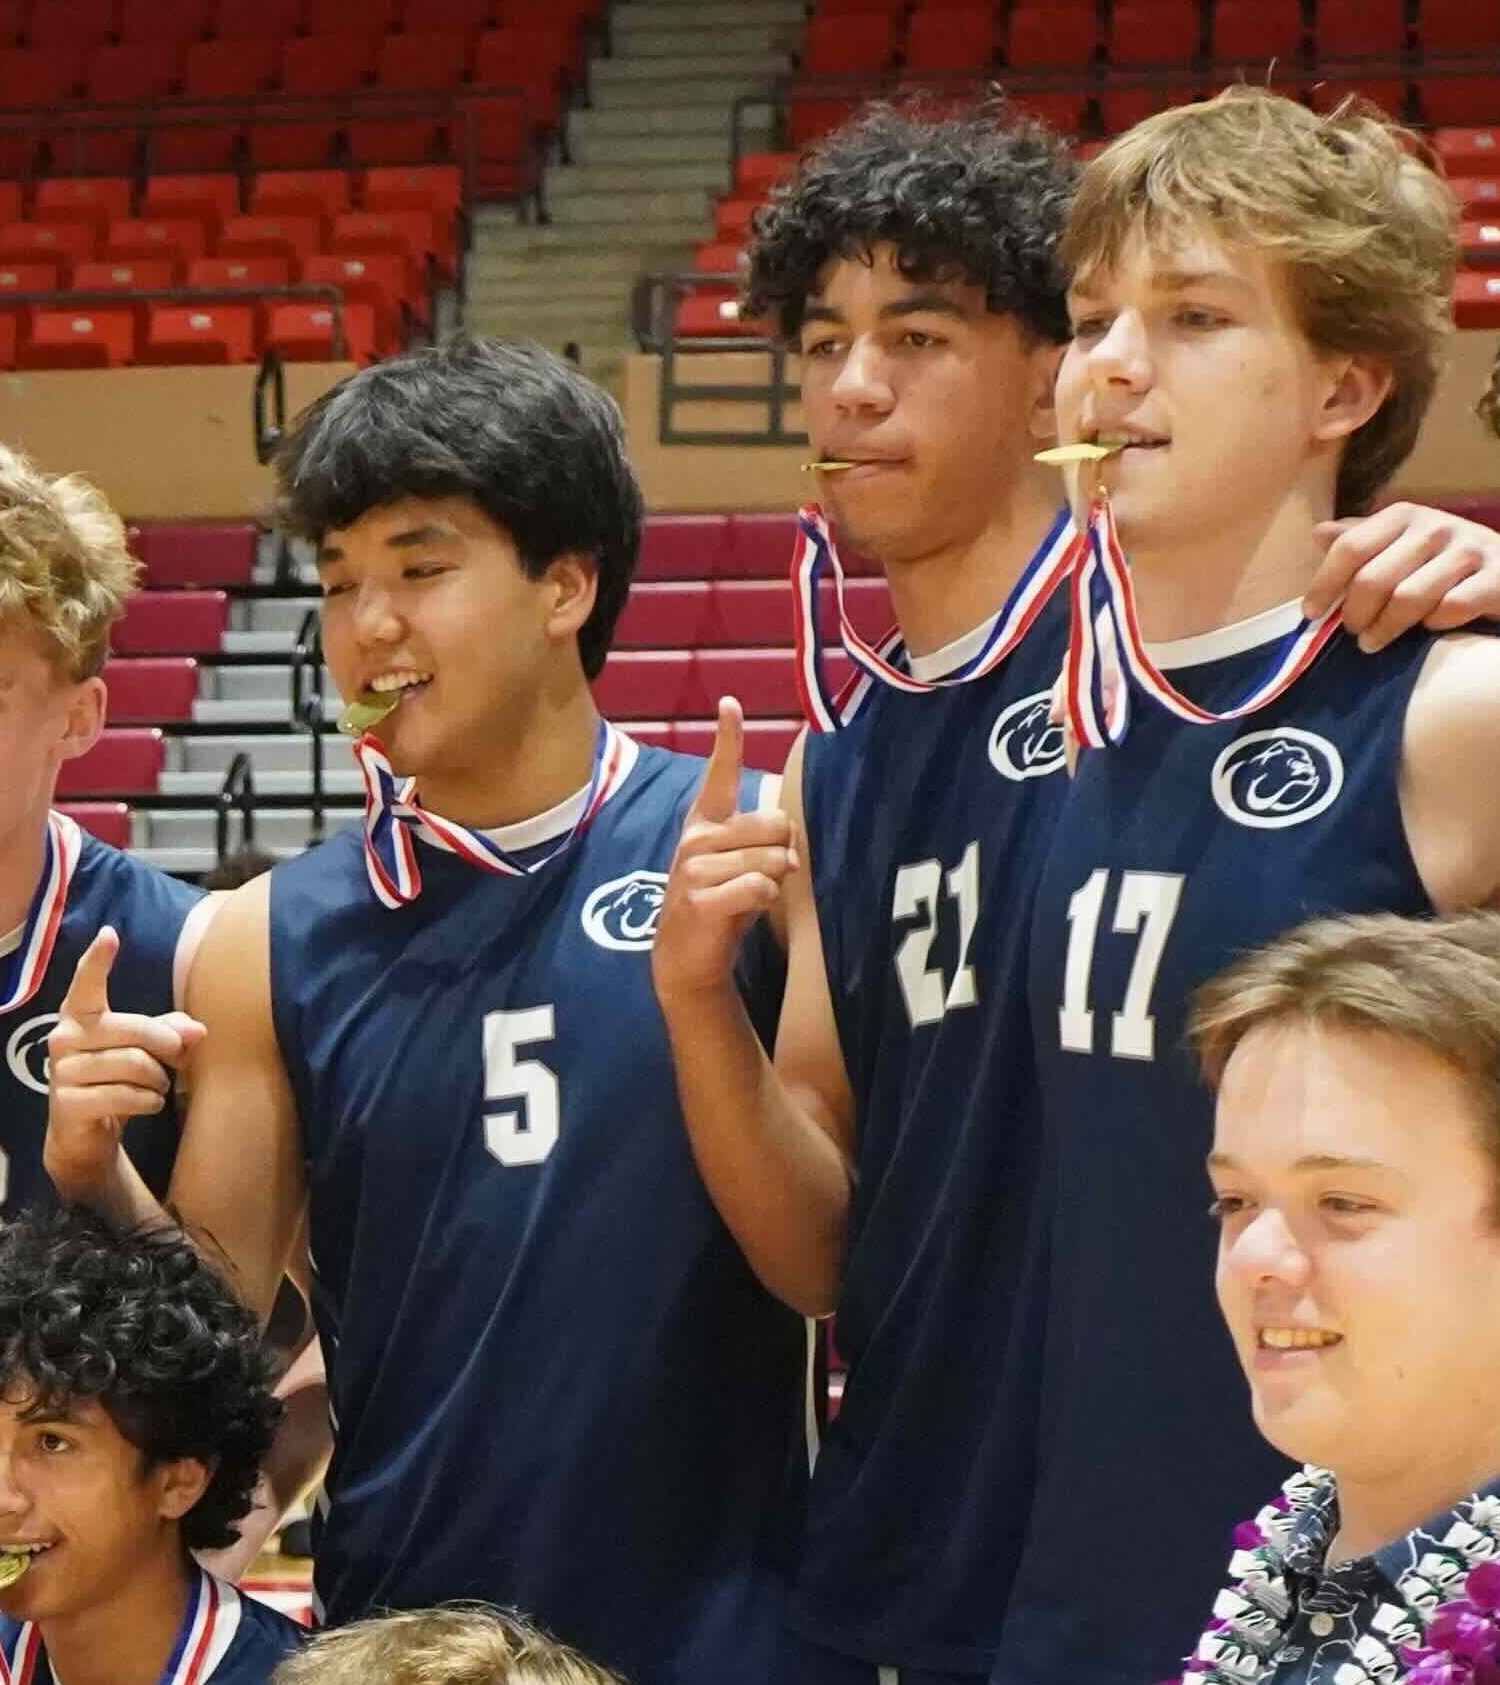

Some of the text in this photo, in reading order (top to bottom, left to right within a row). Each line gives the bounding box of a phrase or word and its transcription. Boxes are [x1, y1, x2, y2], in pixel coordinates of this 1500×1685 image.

[892, 840, 980, 1029] 21
[1058, 867, 1188, 1061] 17
[482, 1003, 561, 1168] 5
